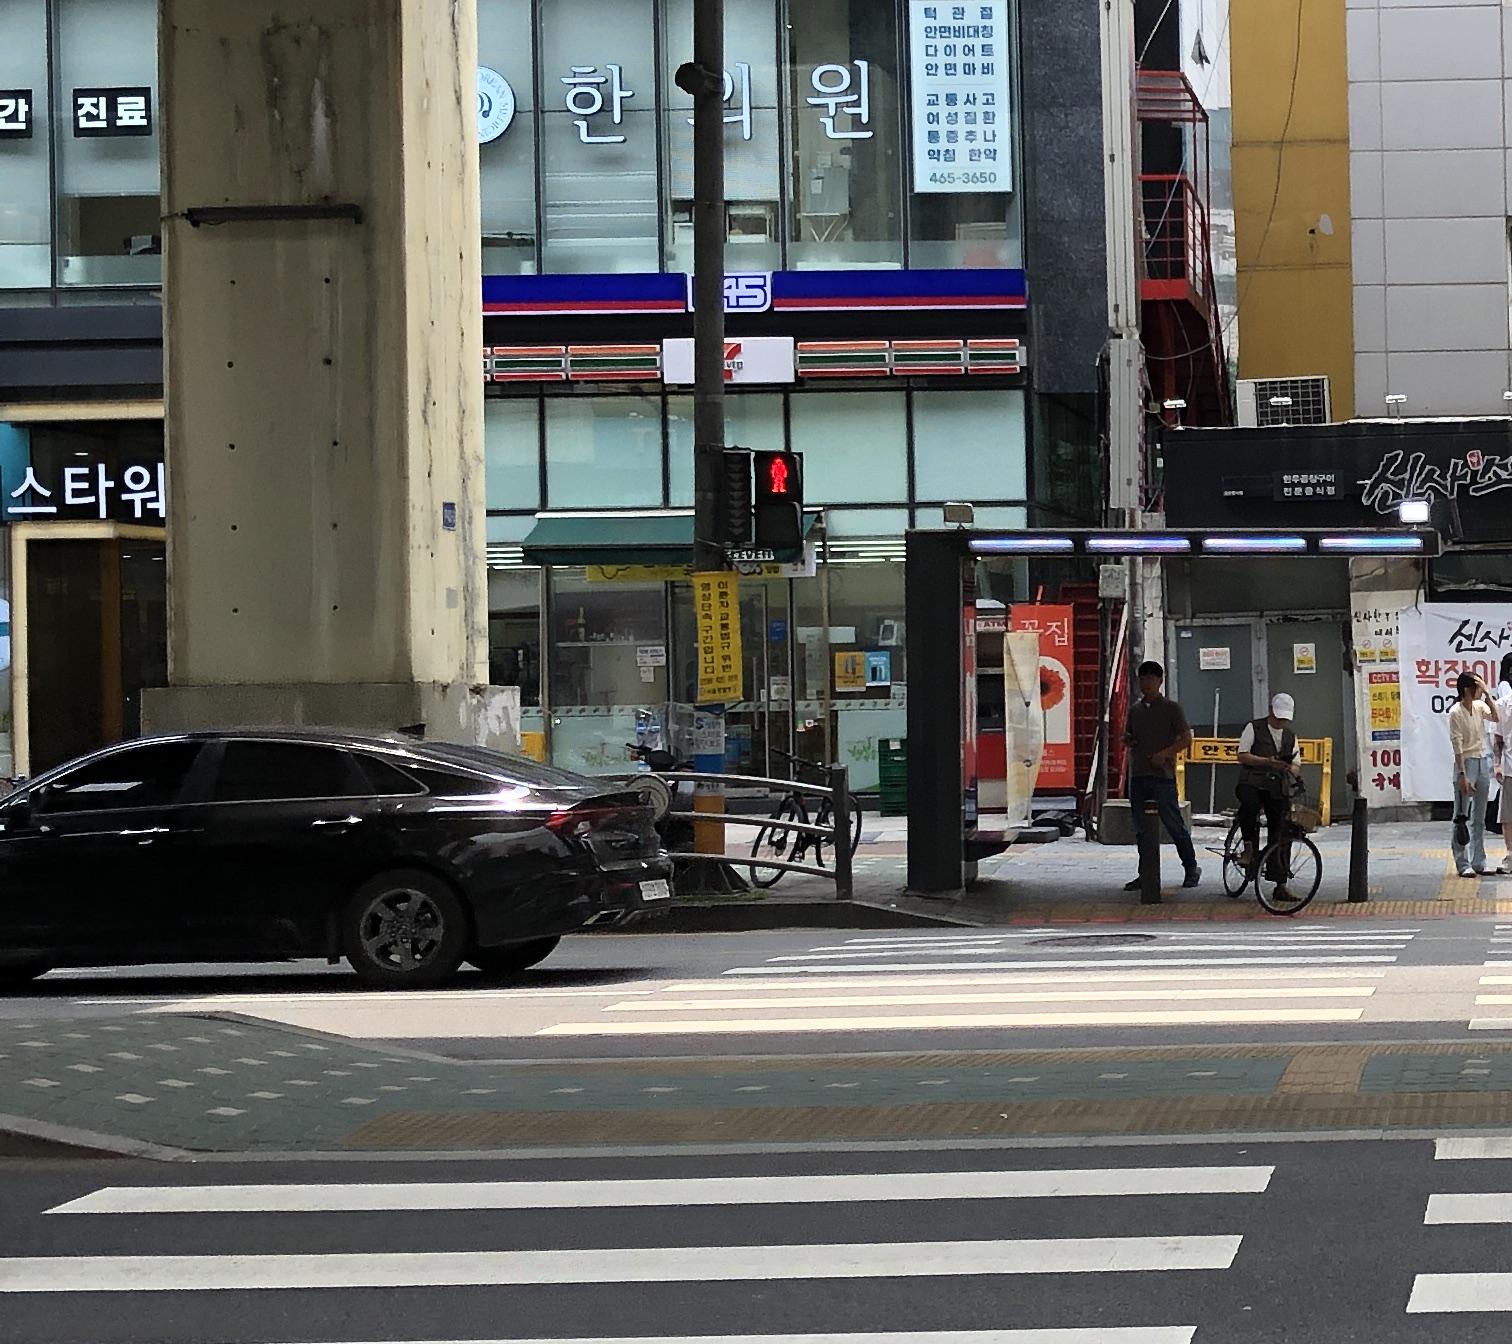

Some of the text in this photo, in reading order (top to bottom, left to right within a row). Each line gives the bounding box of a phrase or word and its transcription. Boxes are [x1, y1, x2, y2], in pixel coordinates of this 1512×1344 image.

[924, 25, 994, 39] 안면비대칭
[925, 44, 994, 57] 다이어트
[925, 63, 995, 76] 안면마비
[926, 92, 996, 106] 교통사고
[77, 96, 148, 129] 진료
[929, 172, 997, 184] 465-3650
[1415, 658, 1498, 689] 확장이
